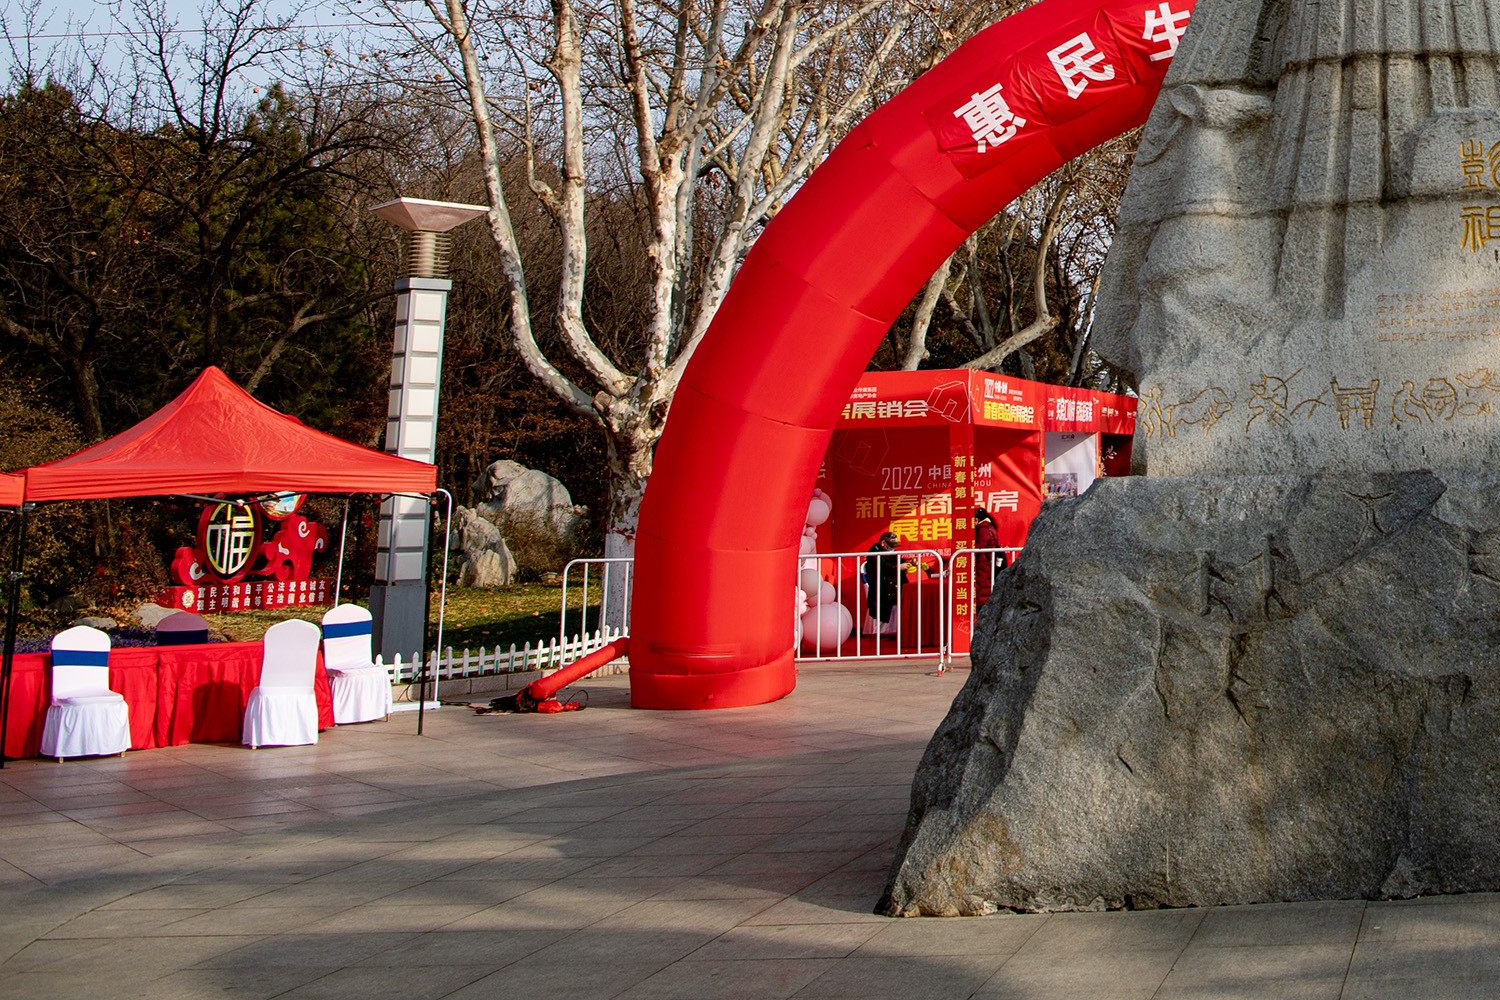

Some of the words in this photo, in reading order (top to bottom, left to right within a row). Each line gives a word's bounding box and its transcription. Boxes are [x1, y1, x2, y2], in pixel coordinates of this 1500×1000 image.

[882, 465, 923, 491] 2022
[974, 462, 992, 478] 州
[954, 455, 967, 530] 新春第一展
[266, 583, 274, 605] 公正
